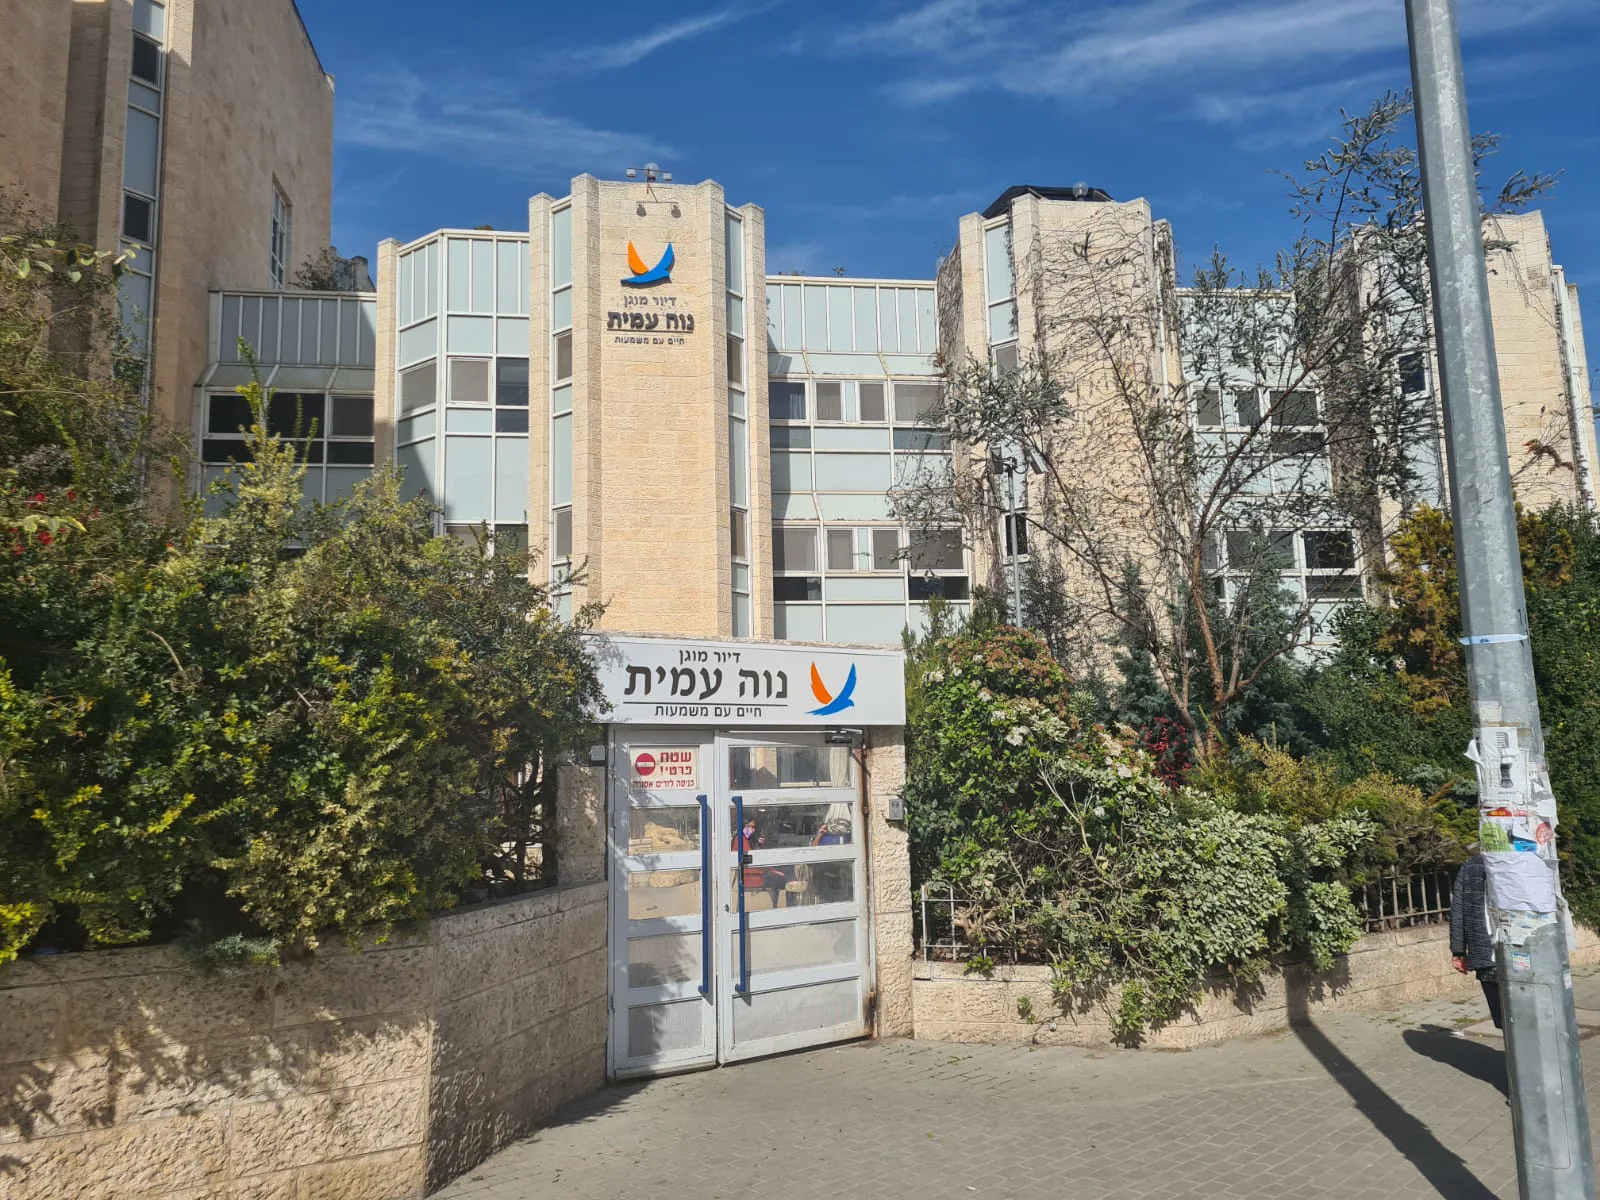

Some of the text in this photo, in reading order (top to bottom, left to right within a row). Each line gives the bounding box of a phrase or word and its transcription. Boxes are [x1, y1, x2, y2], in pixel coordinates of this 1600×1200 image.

[623, 295, 677, 308] דיור מוגן
[606, 311, 660, 330] עמית
[614, 335, 685, 345] חיים עם משמעות
[679, 649, 741, 666] דיור מוגן
[623, 663, 789, 701] נוה עמית
[654, 704, 763, 718] חיים עם משמעות
[660, 751, 692, 763] שטח
[660, 765, 692, 776] פרטי!
